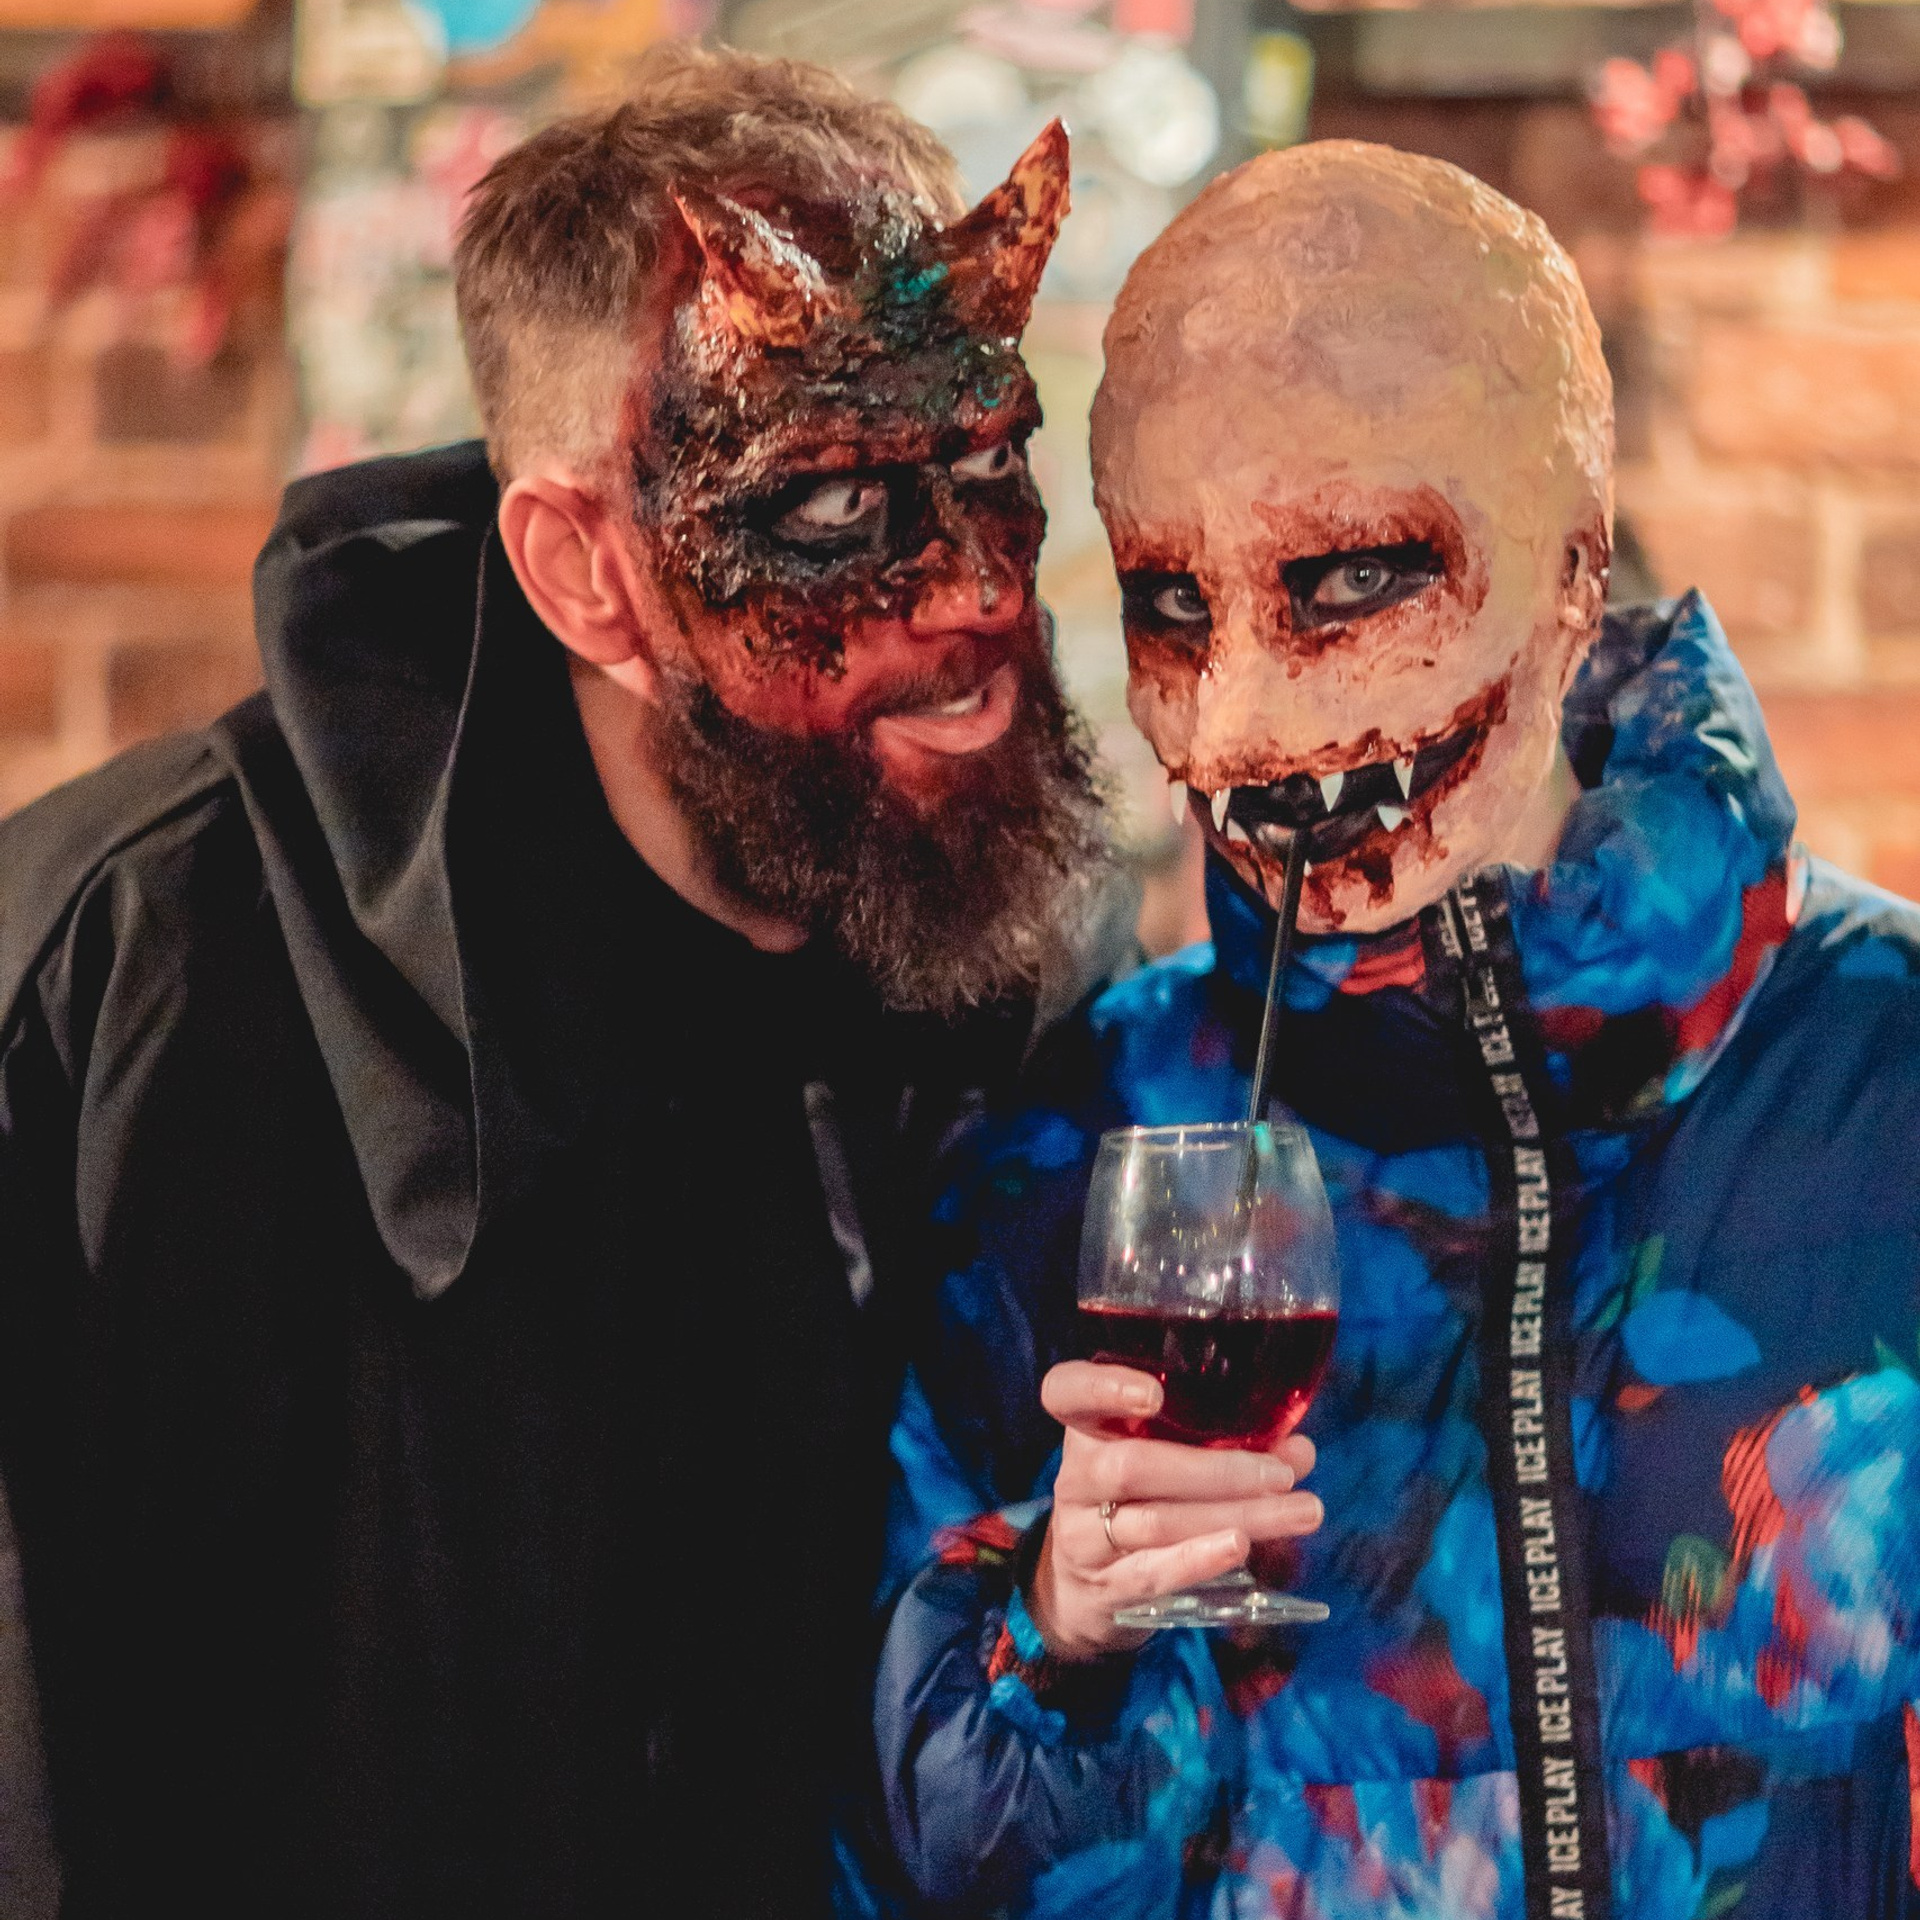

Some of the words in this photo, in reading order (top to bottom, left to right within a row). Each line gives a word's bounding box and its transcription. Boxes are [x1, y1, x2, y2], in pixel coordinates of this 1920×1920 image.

[1513, 1147, 1549, 1210] PLAY
[1518, 1212, 1550, 1253] ICE
[1511, 1262, 1546, 1315] PLAY
[1510, 1316, 1542, 1357] ICE
[1510, 1370, 1544, 1435] PLAY
[1515, 1437, 1548, 1484] ICE
[1520, 1498, 1556, 1565] PLAY
[1526, 1567, 1561, 1613] ICE
[1531, 1626, 1568, 1695] PLAY
[1537, 1697, 1572, 1743] ICE
[1542, 1756, 1577, 1825] PLAY
[1547, 1827, 1581, 1873] ICE
